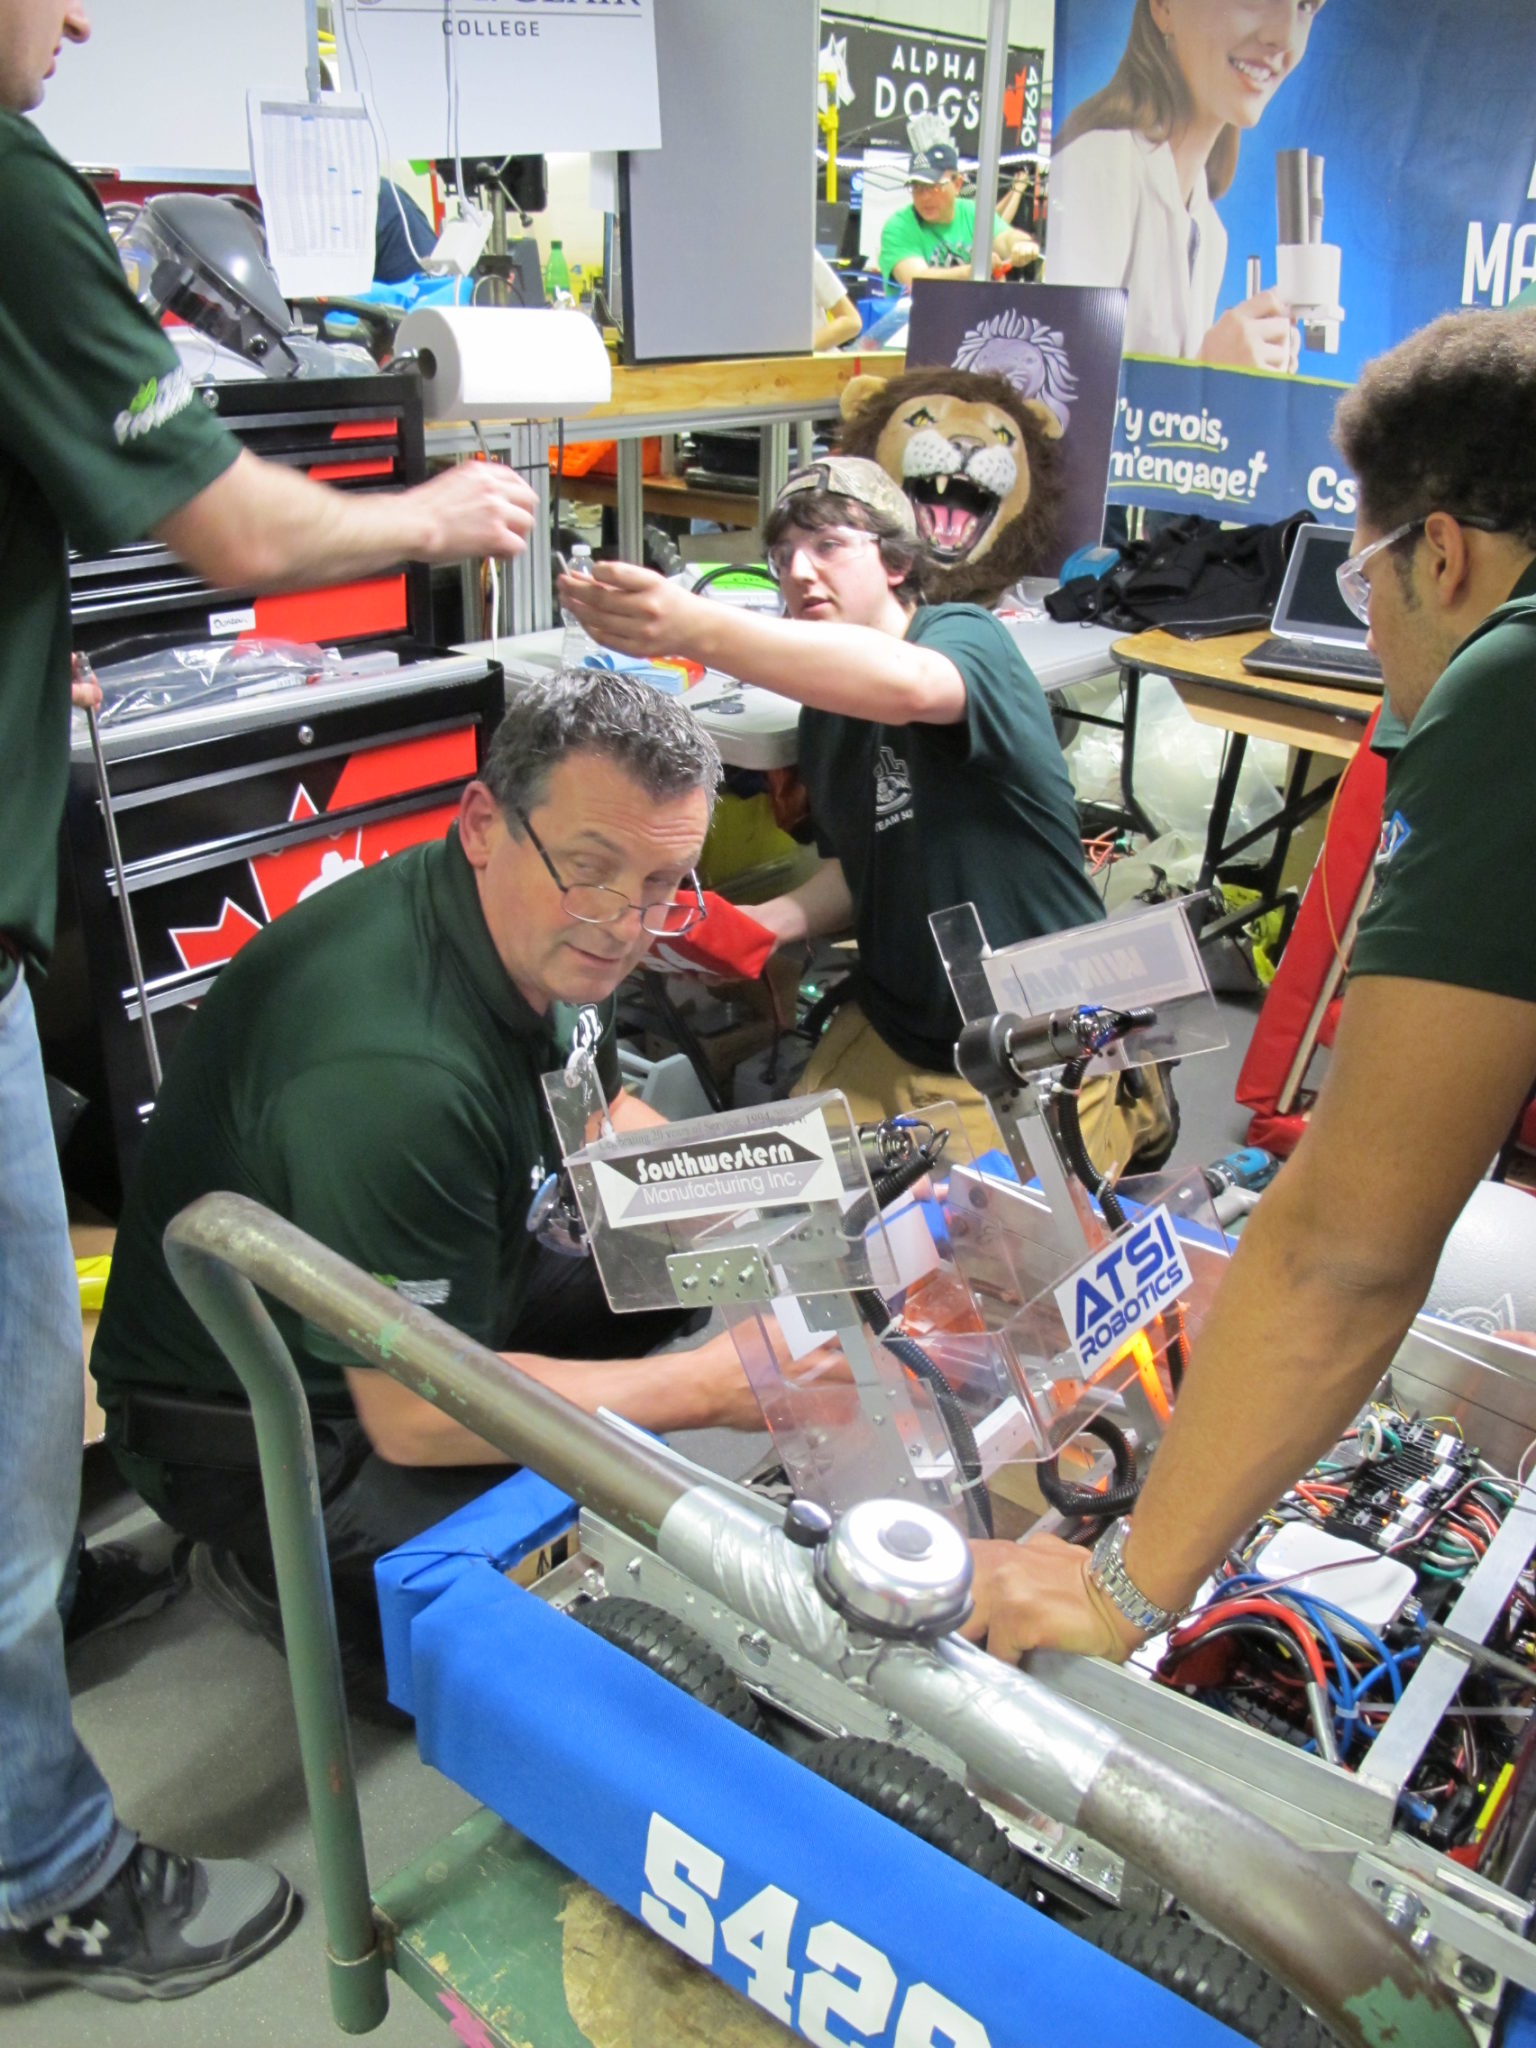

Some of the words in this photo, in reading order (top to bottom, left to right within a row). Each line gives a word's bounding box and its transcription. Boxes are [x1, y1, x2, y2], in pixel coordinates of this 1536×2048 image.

[442, 19, 540, 37] COLLEGE
[892, 45, 976, 82] ALPHA
[874, 76, 980, 130] DOGS
[1021, 65, 1039, 147] 4946
[1115, 395, 1143, 442] 'y
[1148, 408, 1229, 451] crois,
[636, 1141, 795, 1184] Southwestern
[643, 1172, 764, 1205] Manufacturing
[768, 1170, 802, 1187] Inc.
[1076, 1213, 1176, 1340] ATSI
[1079, 1261, 1183, 1364] ROBOTICS
